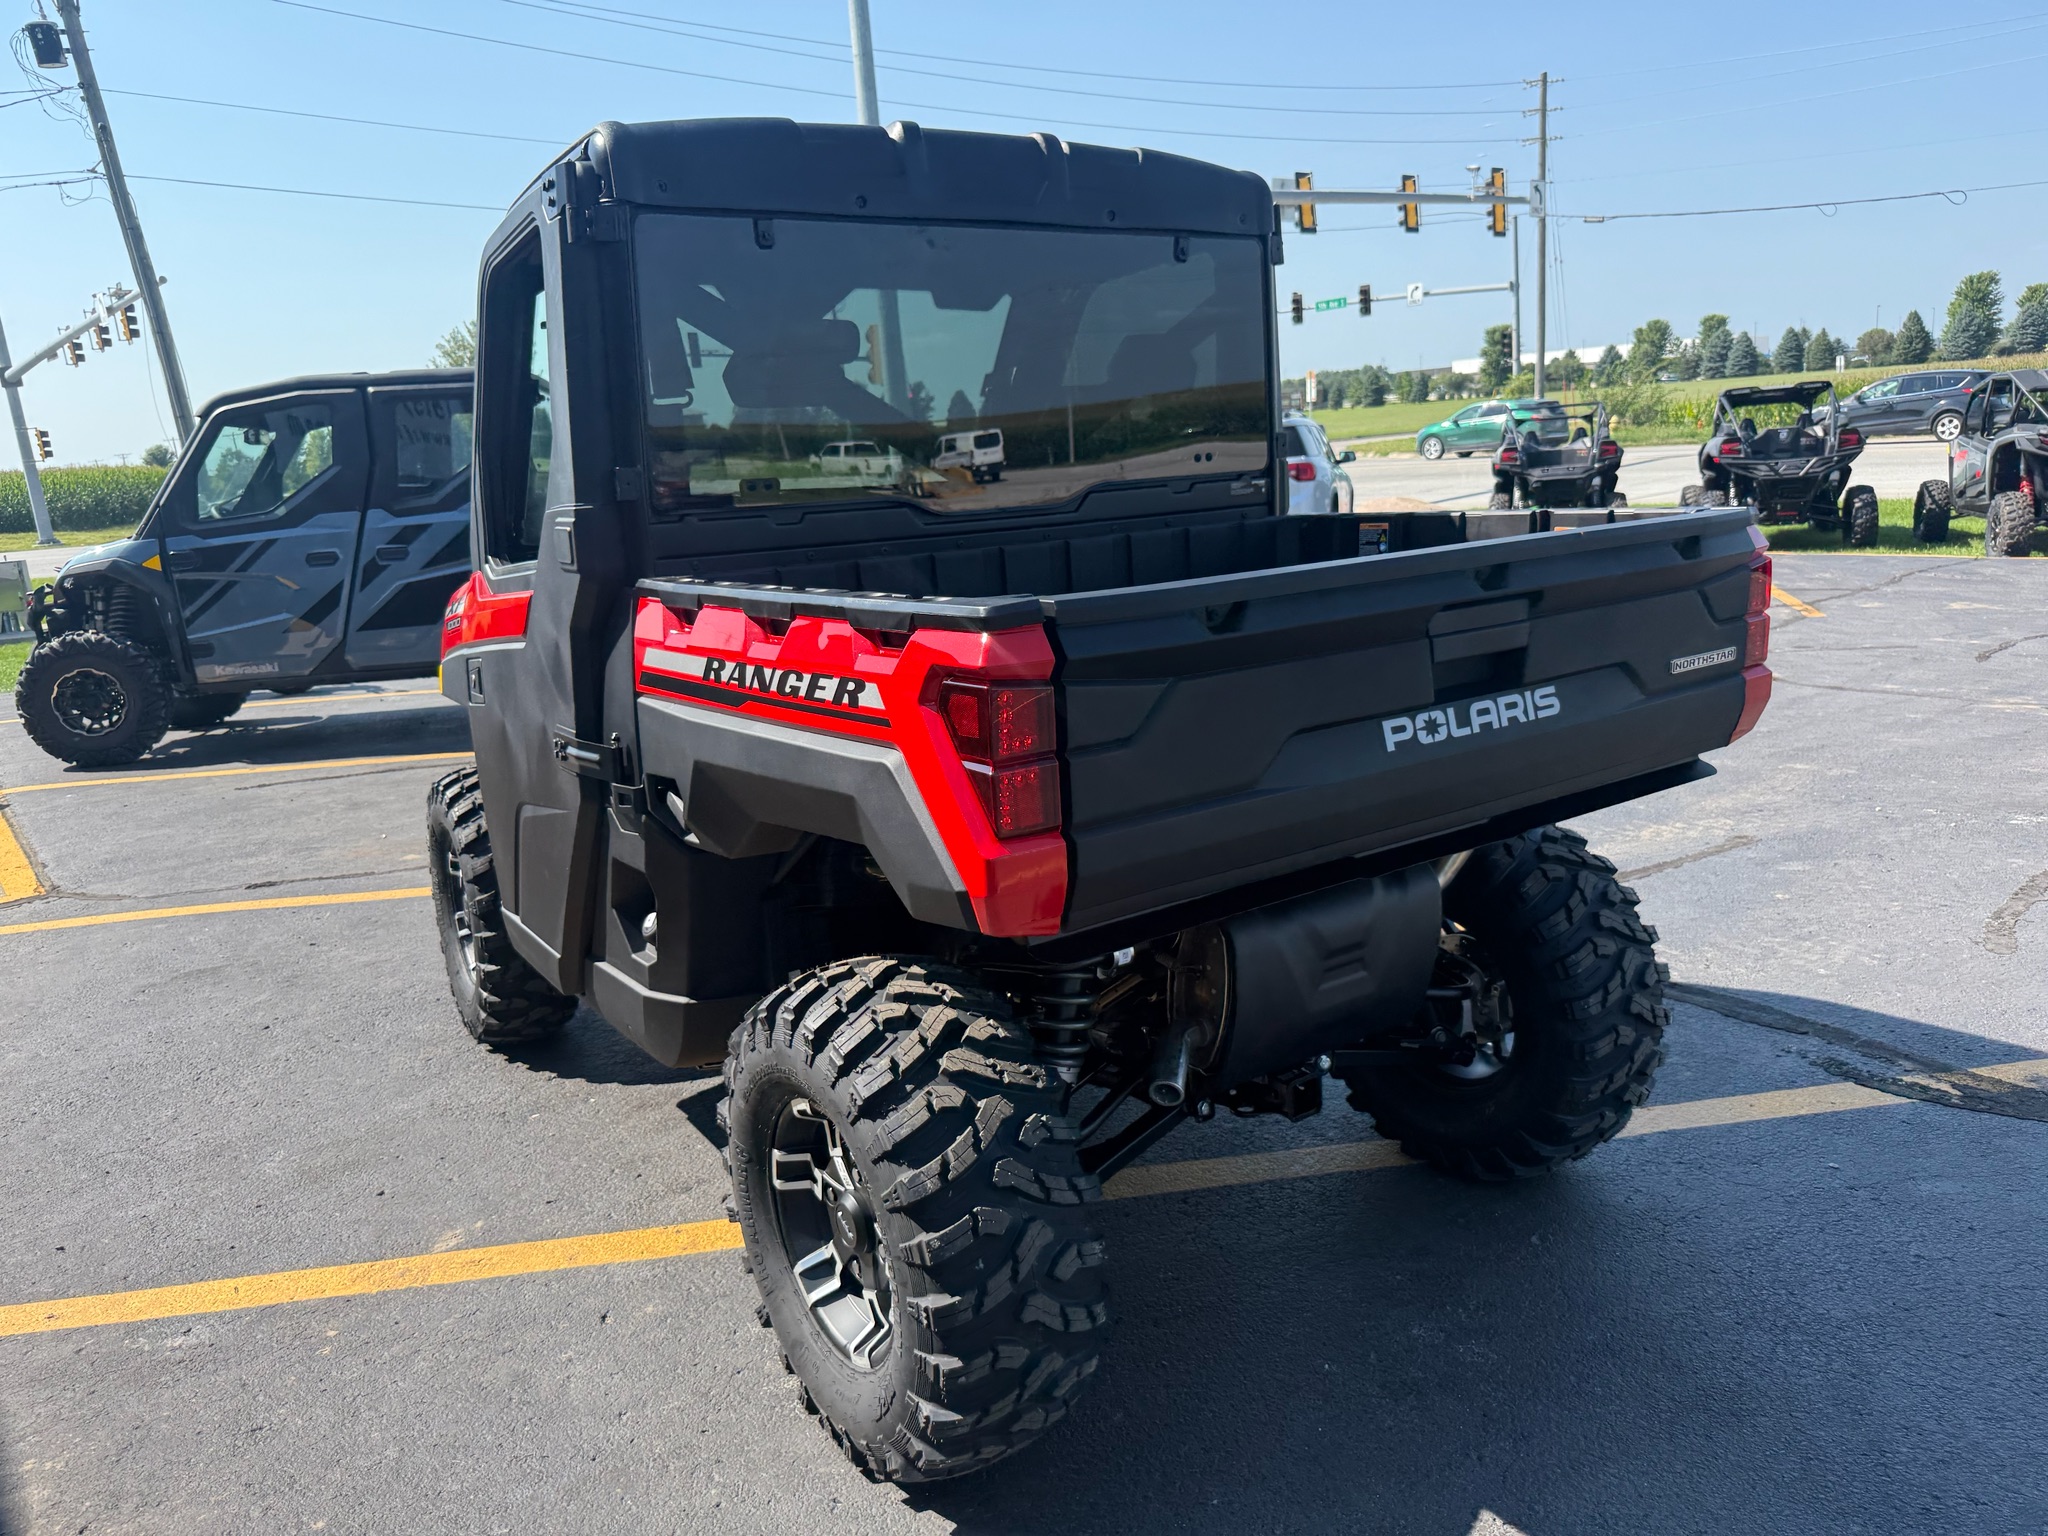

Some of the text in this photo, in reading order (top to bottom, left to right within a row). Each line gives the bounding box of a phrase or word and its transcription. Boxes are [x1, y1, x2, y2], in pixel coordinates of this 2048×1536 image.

[214, 662, 279, 676] Kawasaki
[1674, 649, 1735, 671] NORTHSTAR
[702, 656, 866, 709] RANGER
[1382, 685, 1561, 752] POLARIS
